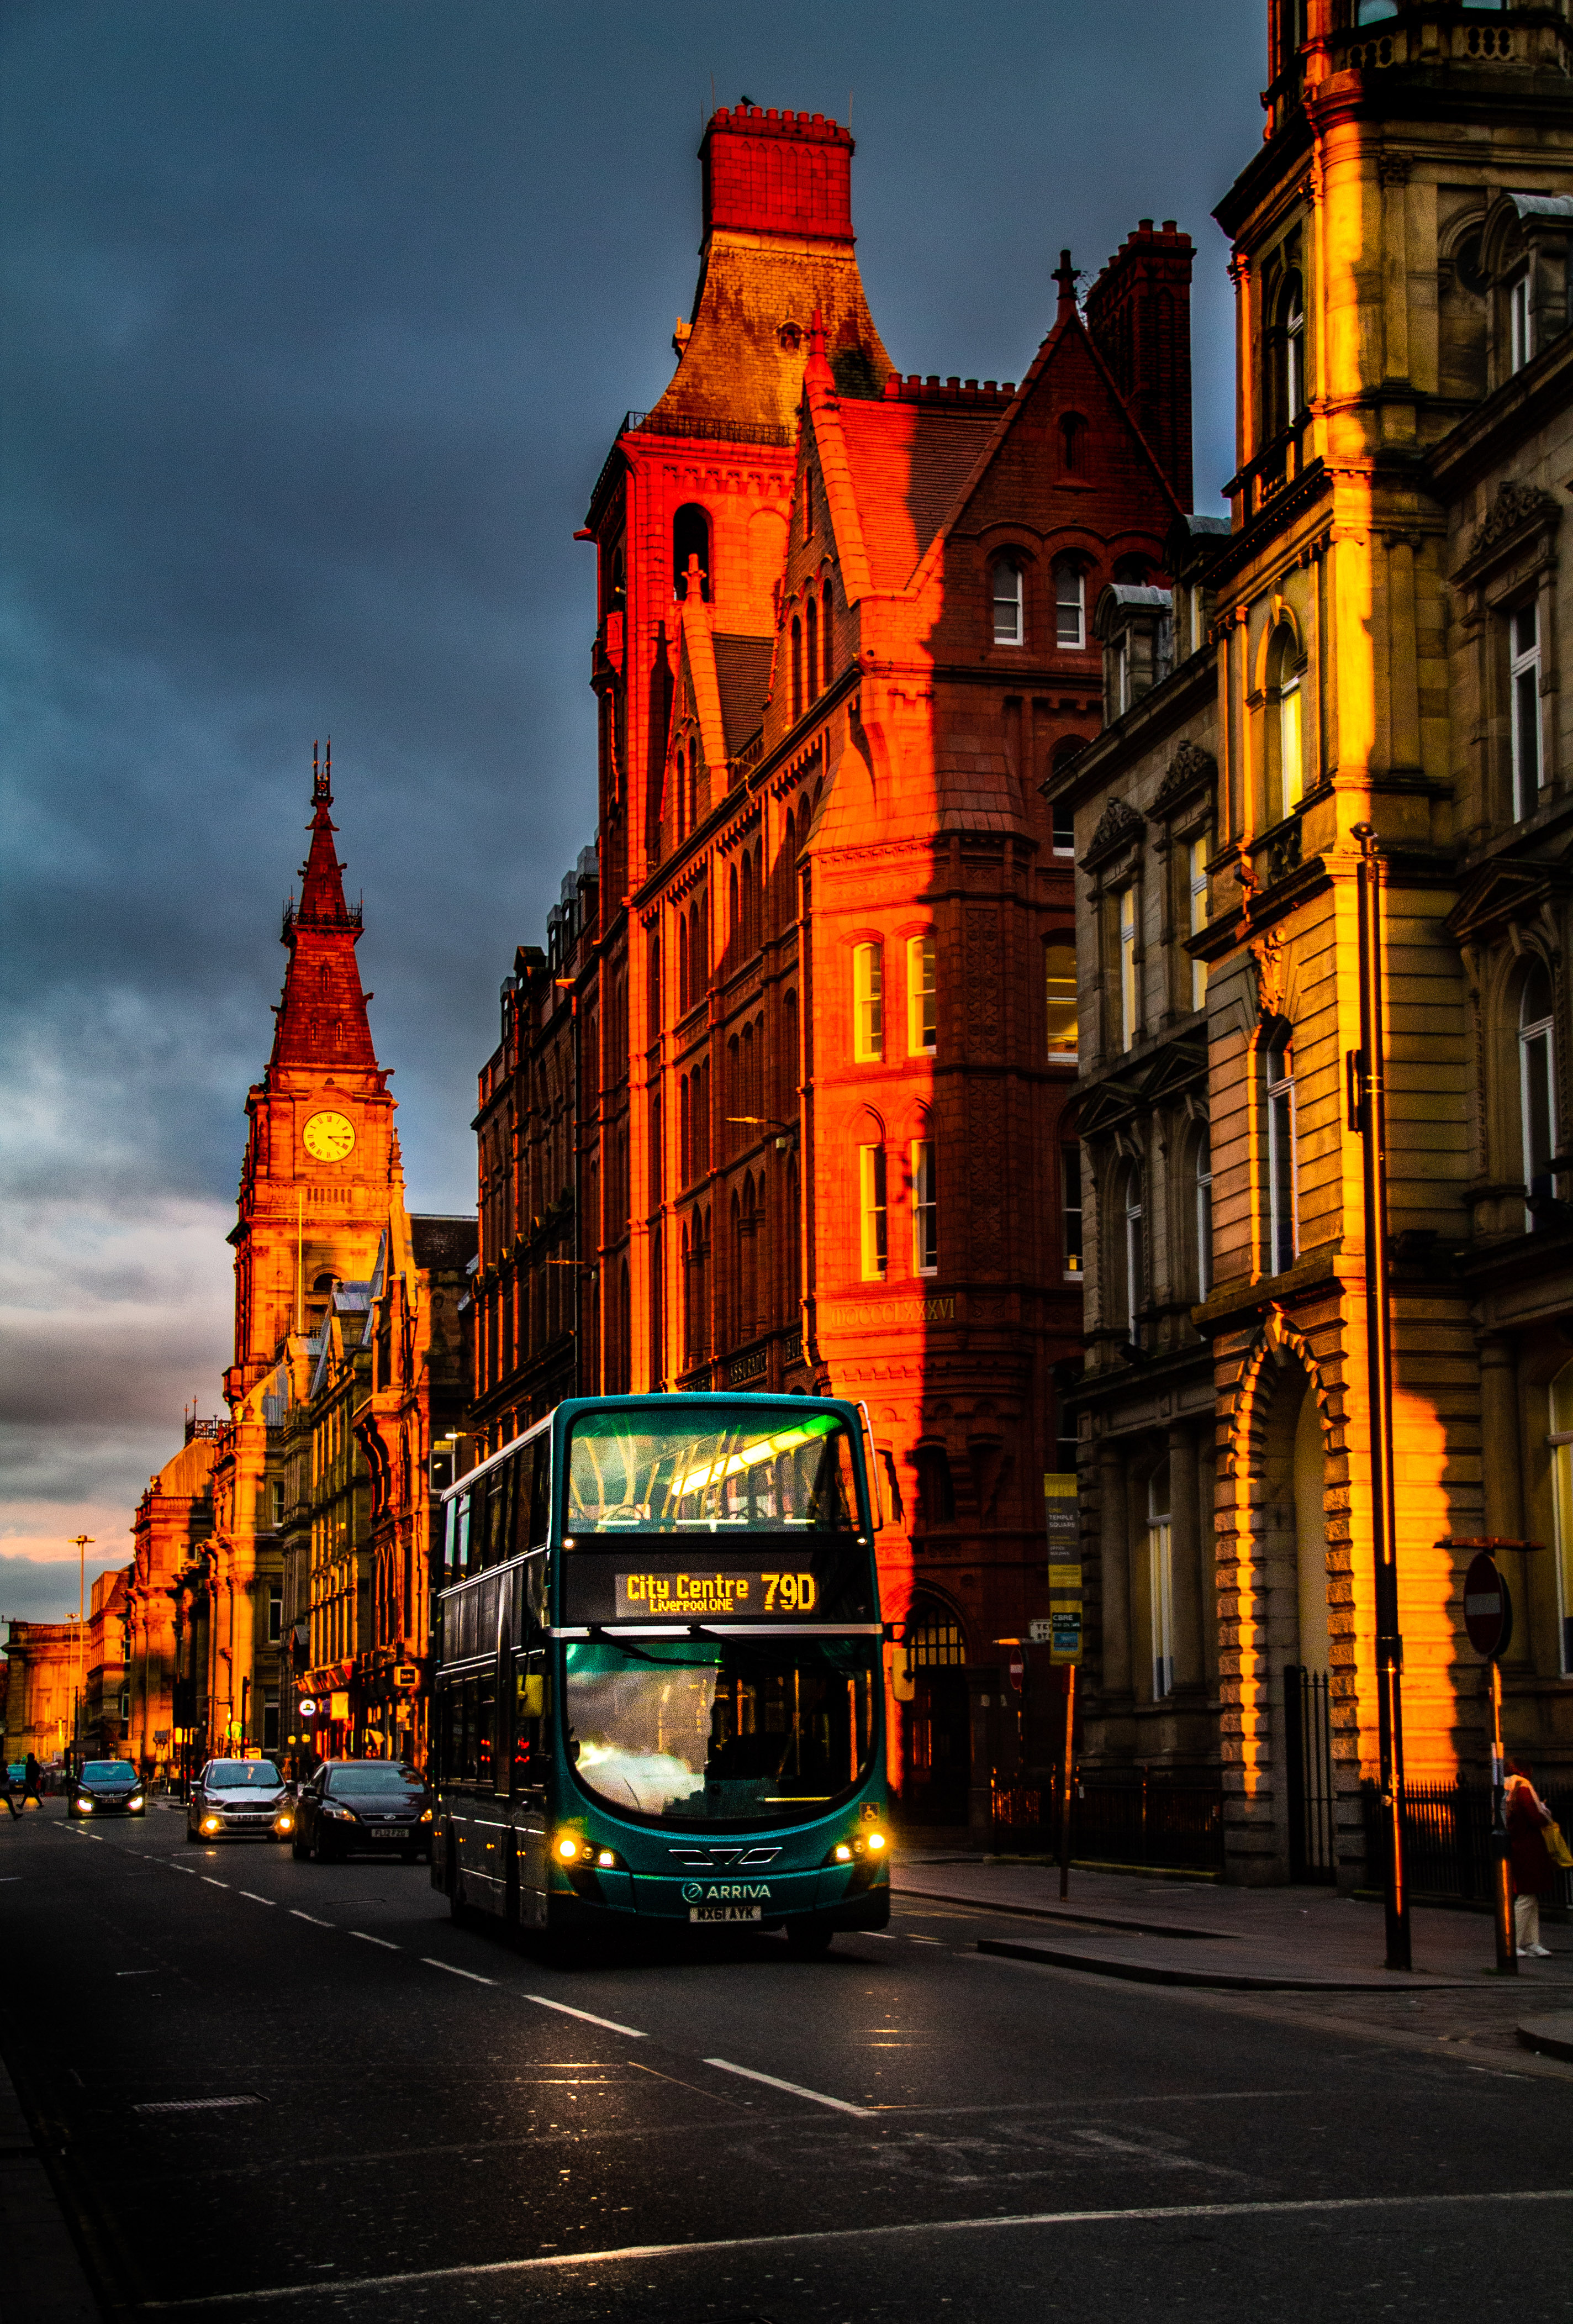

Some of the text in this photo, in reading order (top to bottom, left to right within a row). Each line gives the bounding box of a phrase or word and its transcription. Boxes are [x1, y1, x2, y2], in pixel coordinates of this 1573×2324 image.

[627, 1574, 749, 1600] City Centre
[761, 1574, 816, 1611] 79D
[706, 1885, 772, 1899] ARRIVA
[730, 1906, 754, 1920] AYK
